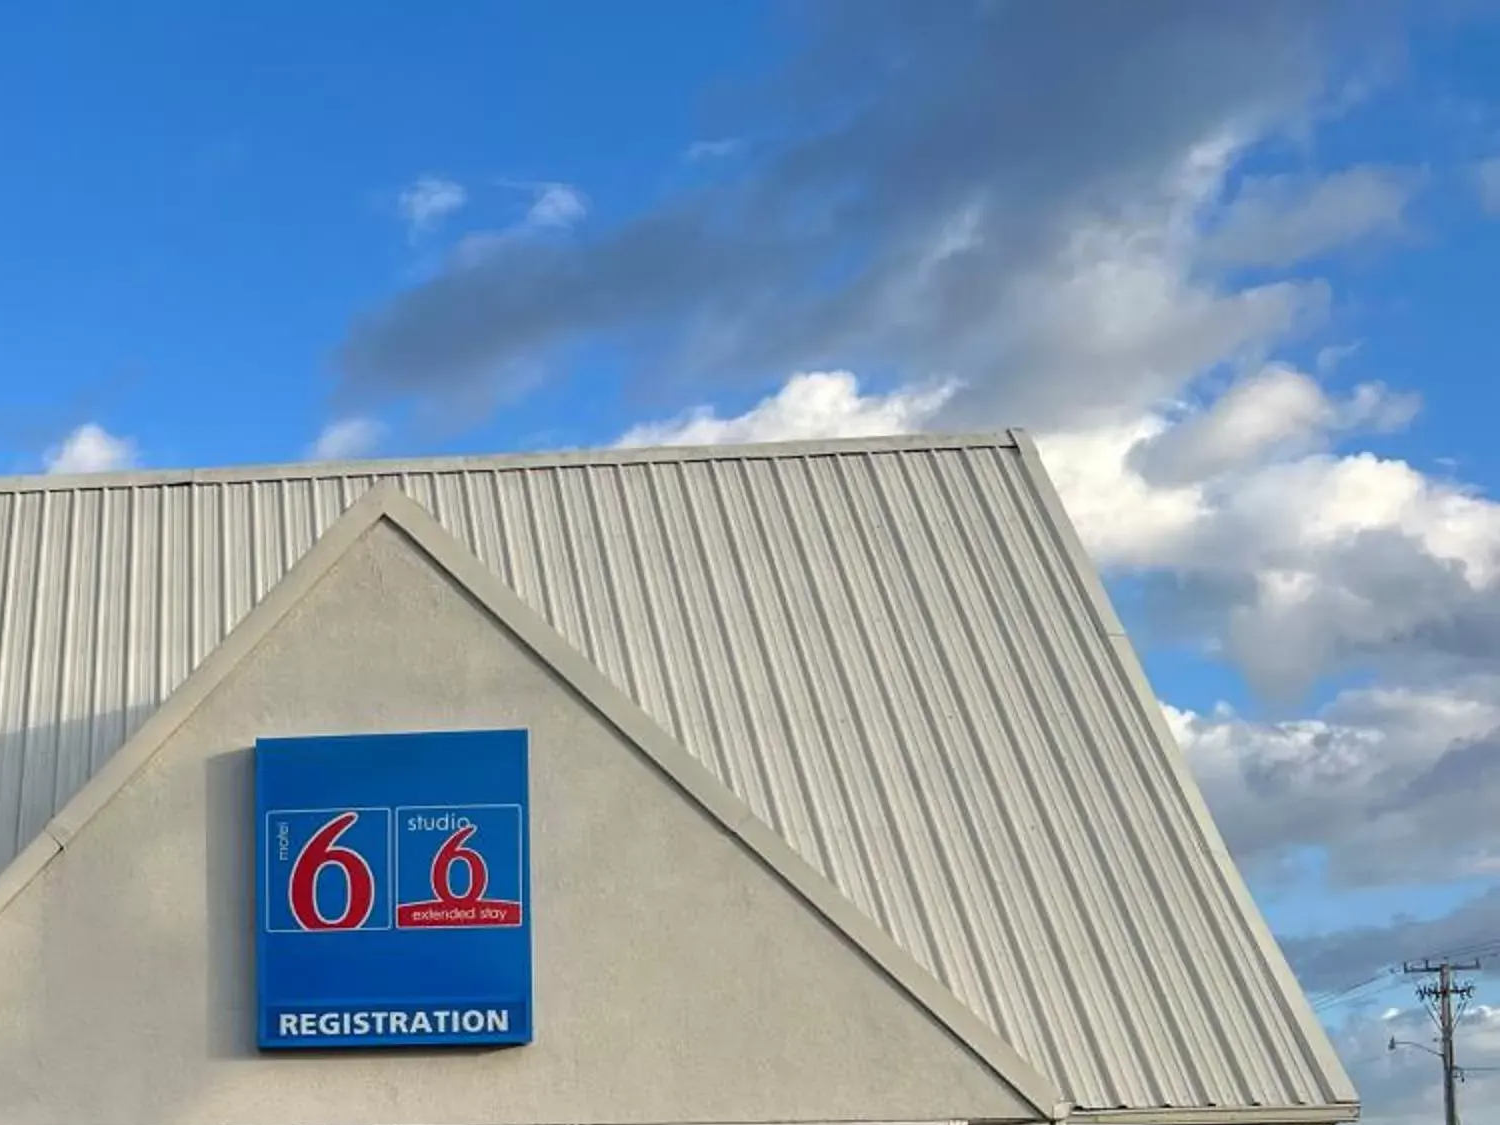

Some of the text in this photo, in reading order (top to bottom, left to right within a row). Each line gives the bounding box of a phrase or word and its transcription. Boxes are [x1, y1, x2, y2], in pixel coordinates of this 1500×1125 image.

[407, 812, 471, 831] studio
[289, 812, 375, 931] 6
[430, 824, 488, 901] 6
[412, 907, 507, 921] extended stay
[279, 1009, 509, 1036] REGISTRATION
